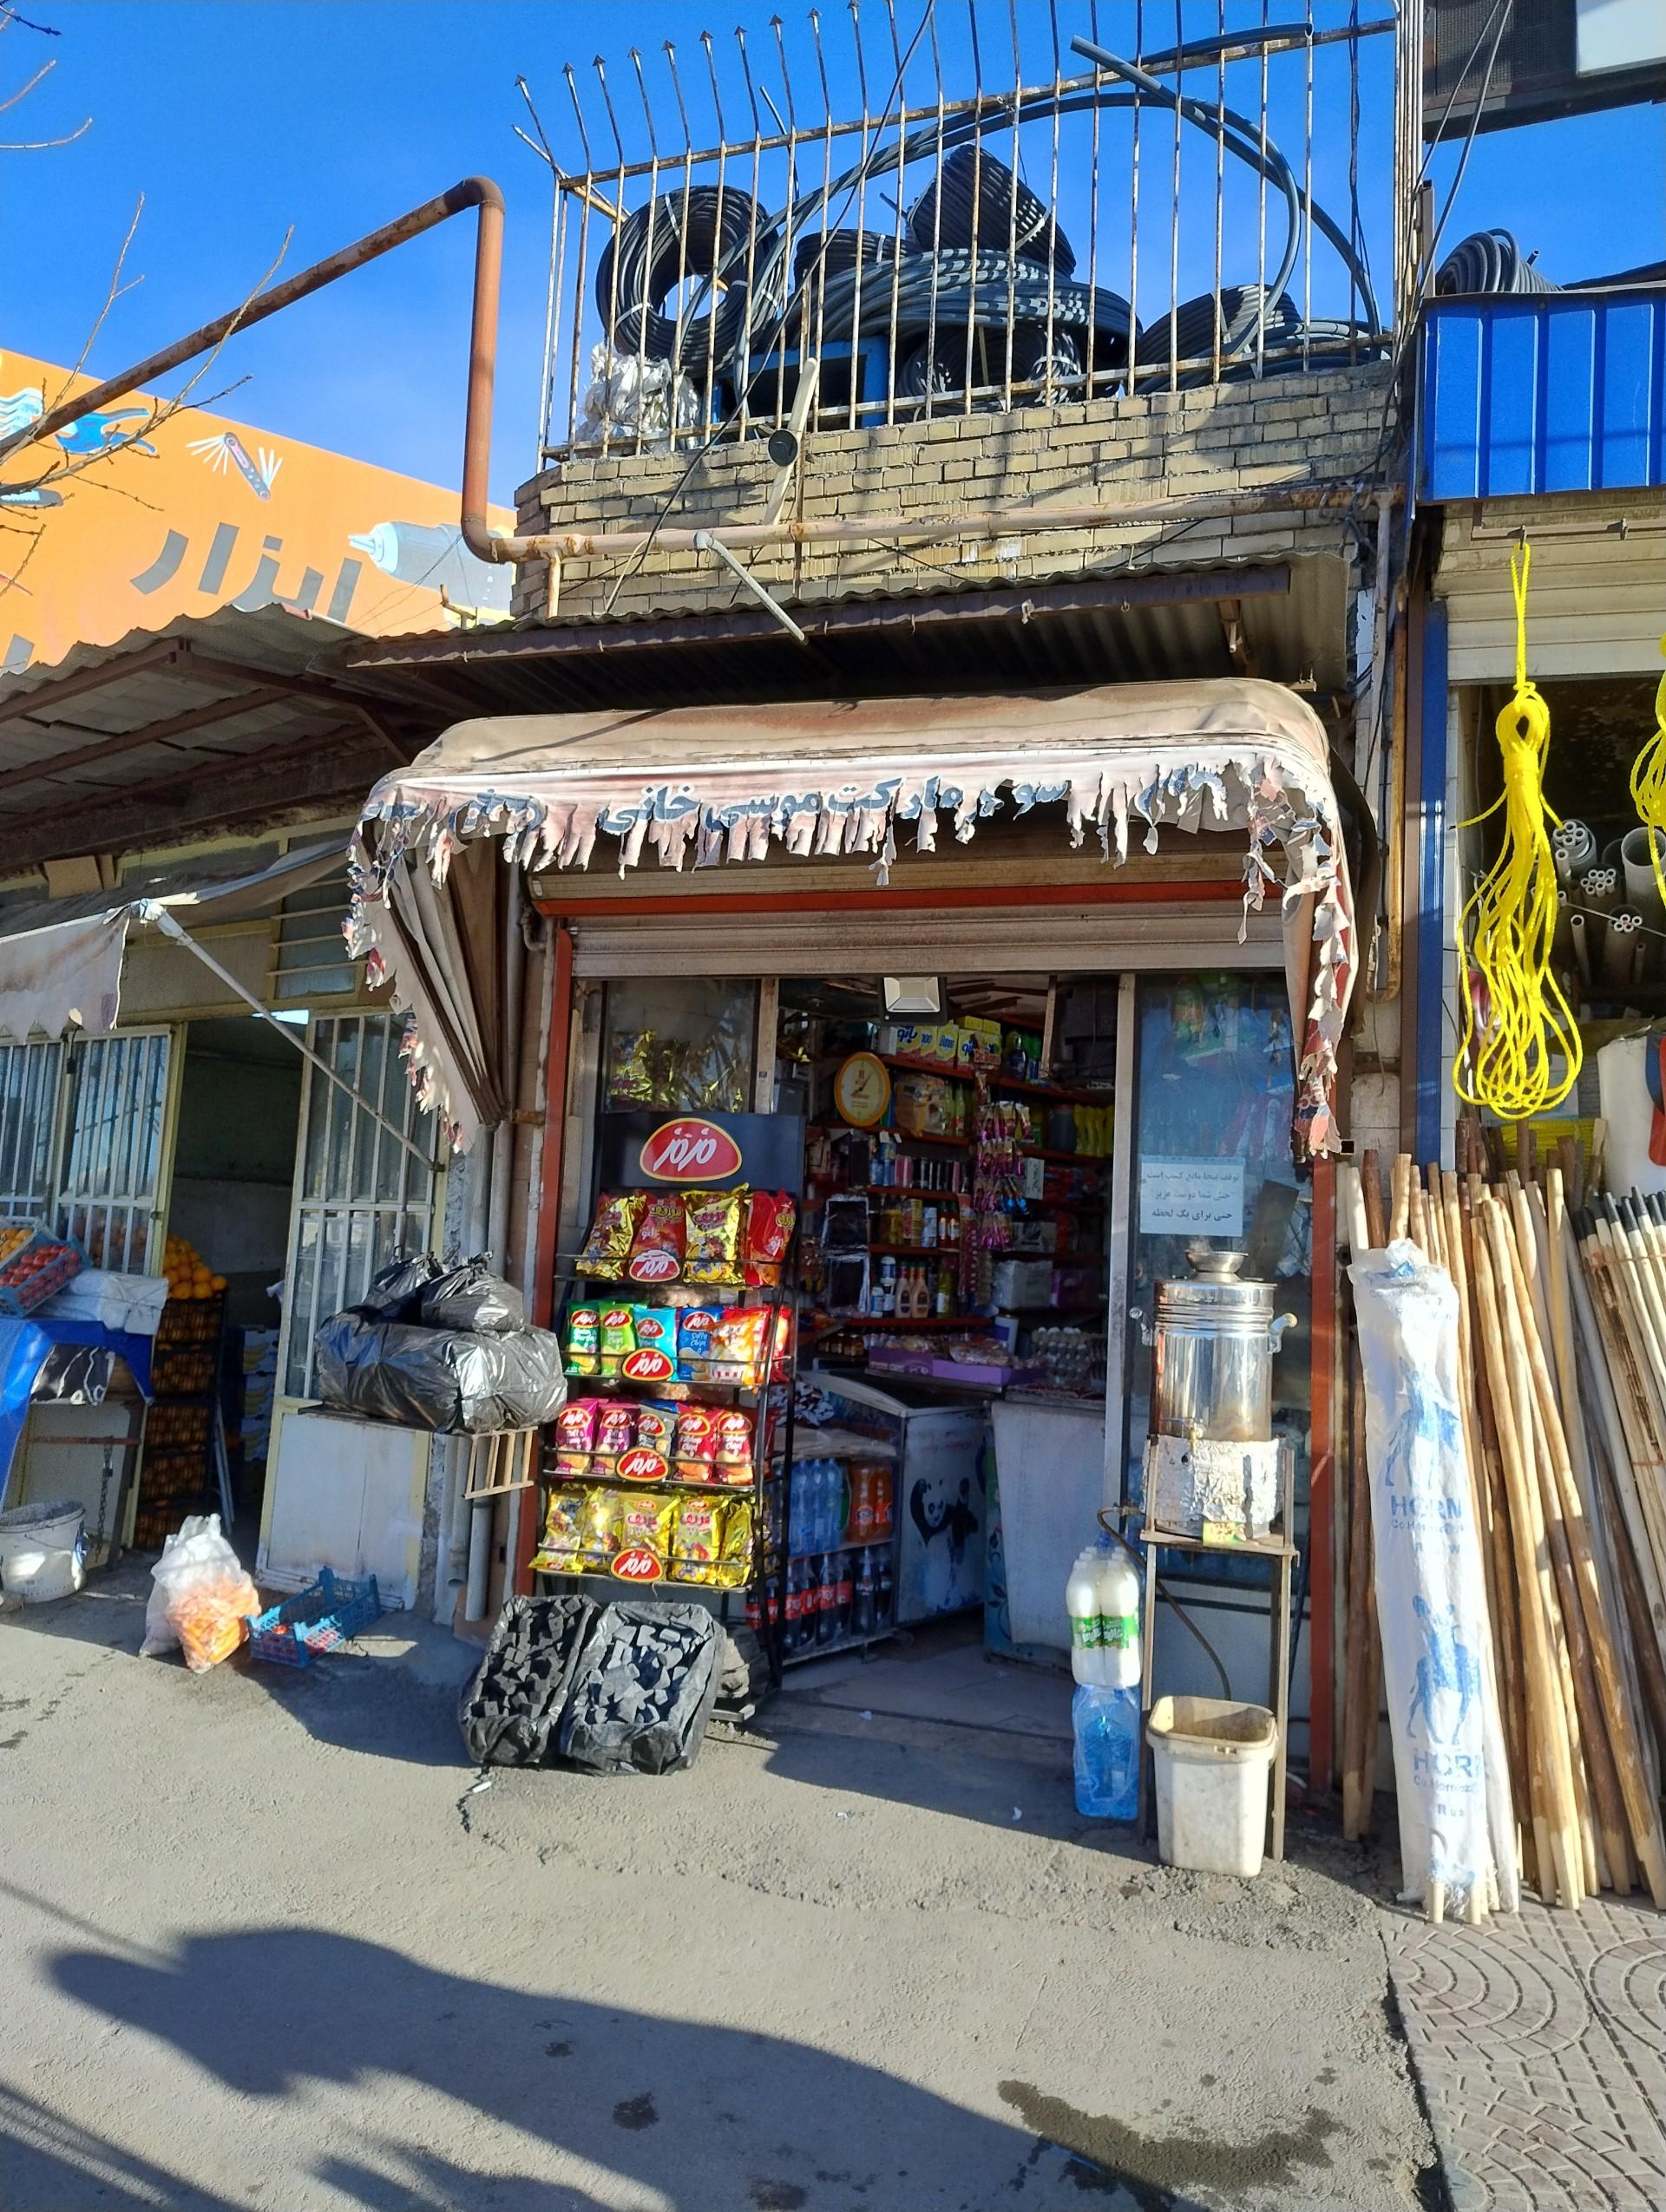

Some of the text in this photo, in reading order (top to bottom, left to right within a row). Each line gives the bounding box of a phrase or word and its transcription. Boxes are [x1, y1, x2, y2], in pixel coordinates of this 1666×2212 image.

[597, 784, 699, 832] خانی
[704, 793, 821, 833] موسی
[828, 774, 963, 820] مارکت
[653, 1127, 718, 1172] مزمز
[1151, 1207, 1232, 1221] حتی برای یک لحظه
[629, 1352, 663, 1377] مزمز
[625, 1452, 658, 1476] مزمز
[618, 1550, 652, 1576] مزمز
